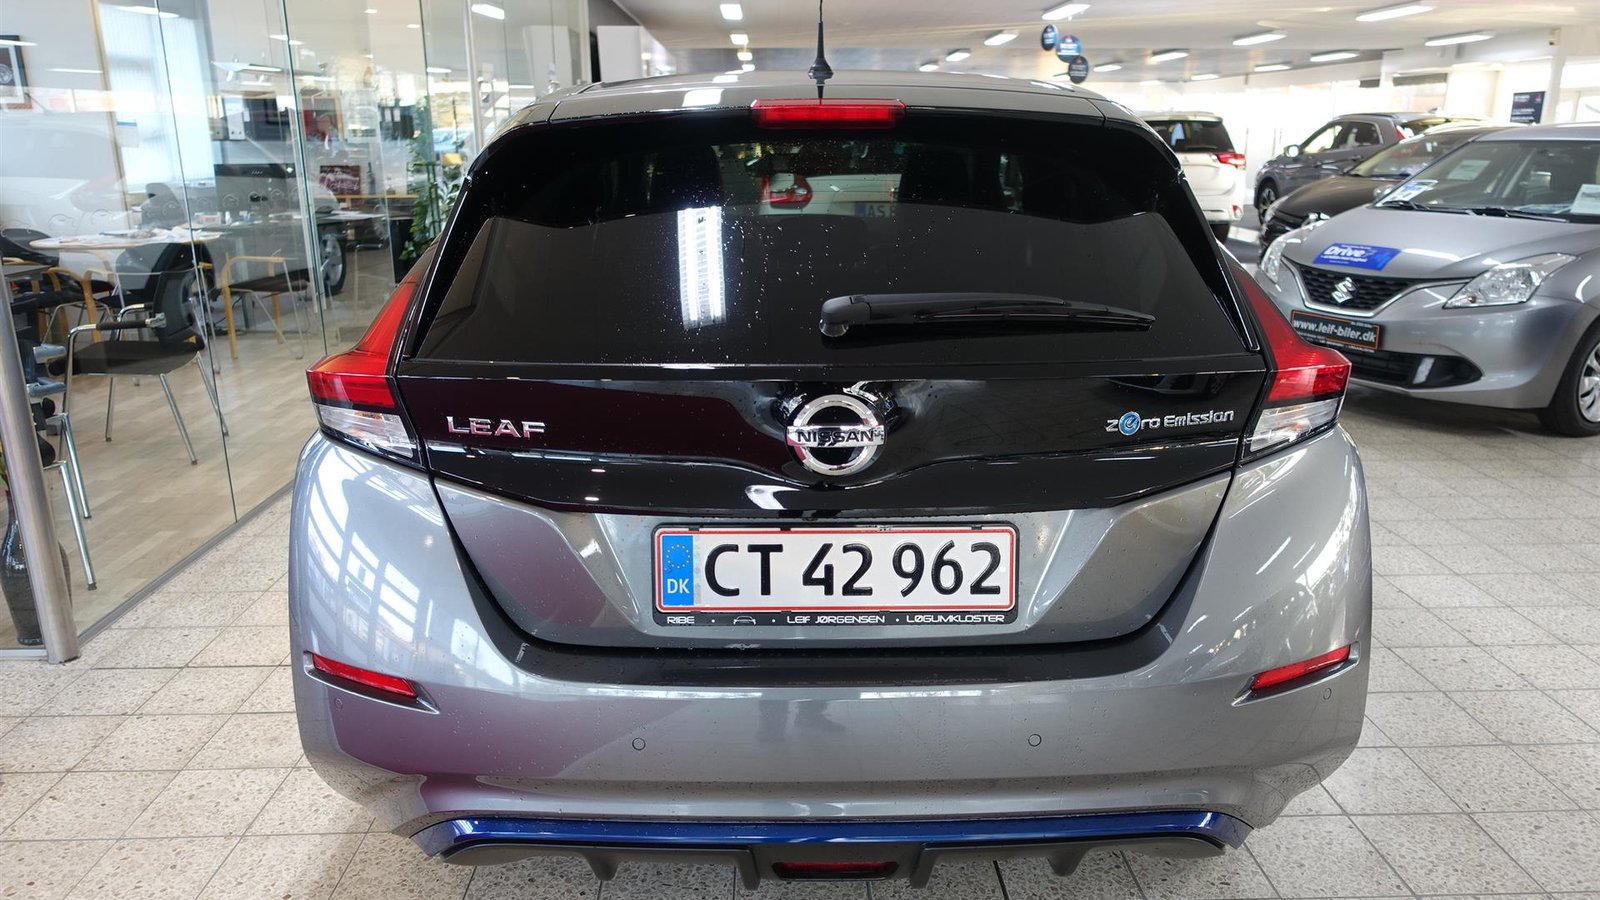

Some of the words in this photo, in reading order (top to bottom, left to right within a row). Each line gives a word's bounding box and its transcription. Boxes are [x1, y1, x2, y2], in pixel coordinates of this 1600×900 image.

[1293, 319, 1376, 342] www.leif-biler.dk
[446, 415, 546, 438] LEAF
[1163, 409, 1235, 428] Emission
[796, 430, 875, 443] NISSAN
[704, 543, 784, 597] CT
[801, 542, 874, 597] 42
[892, 539, 1002, 598] 962
[667, 578, 690, 594] DK
[666, 615, 696, 625] RIBE
[786, 615, 811, 625] LEIF
[814, 614, 886, 625] JØRGENSEN
[906, 613, 1005, 624] LØGUMKLOSTER
